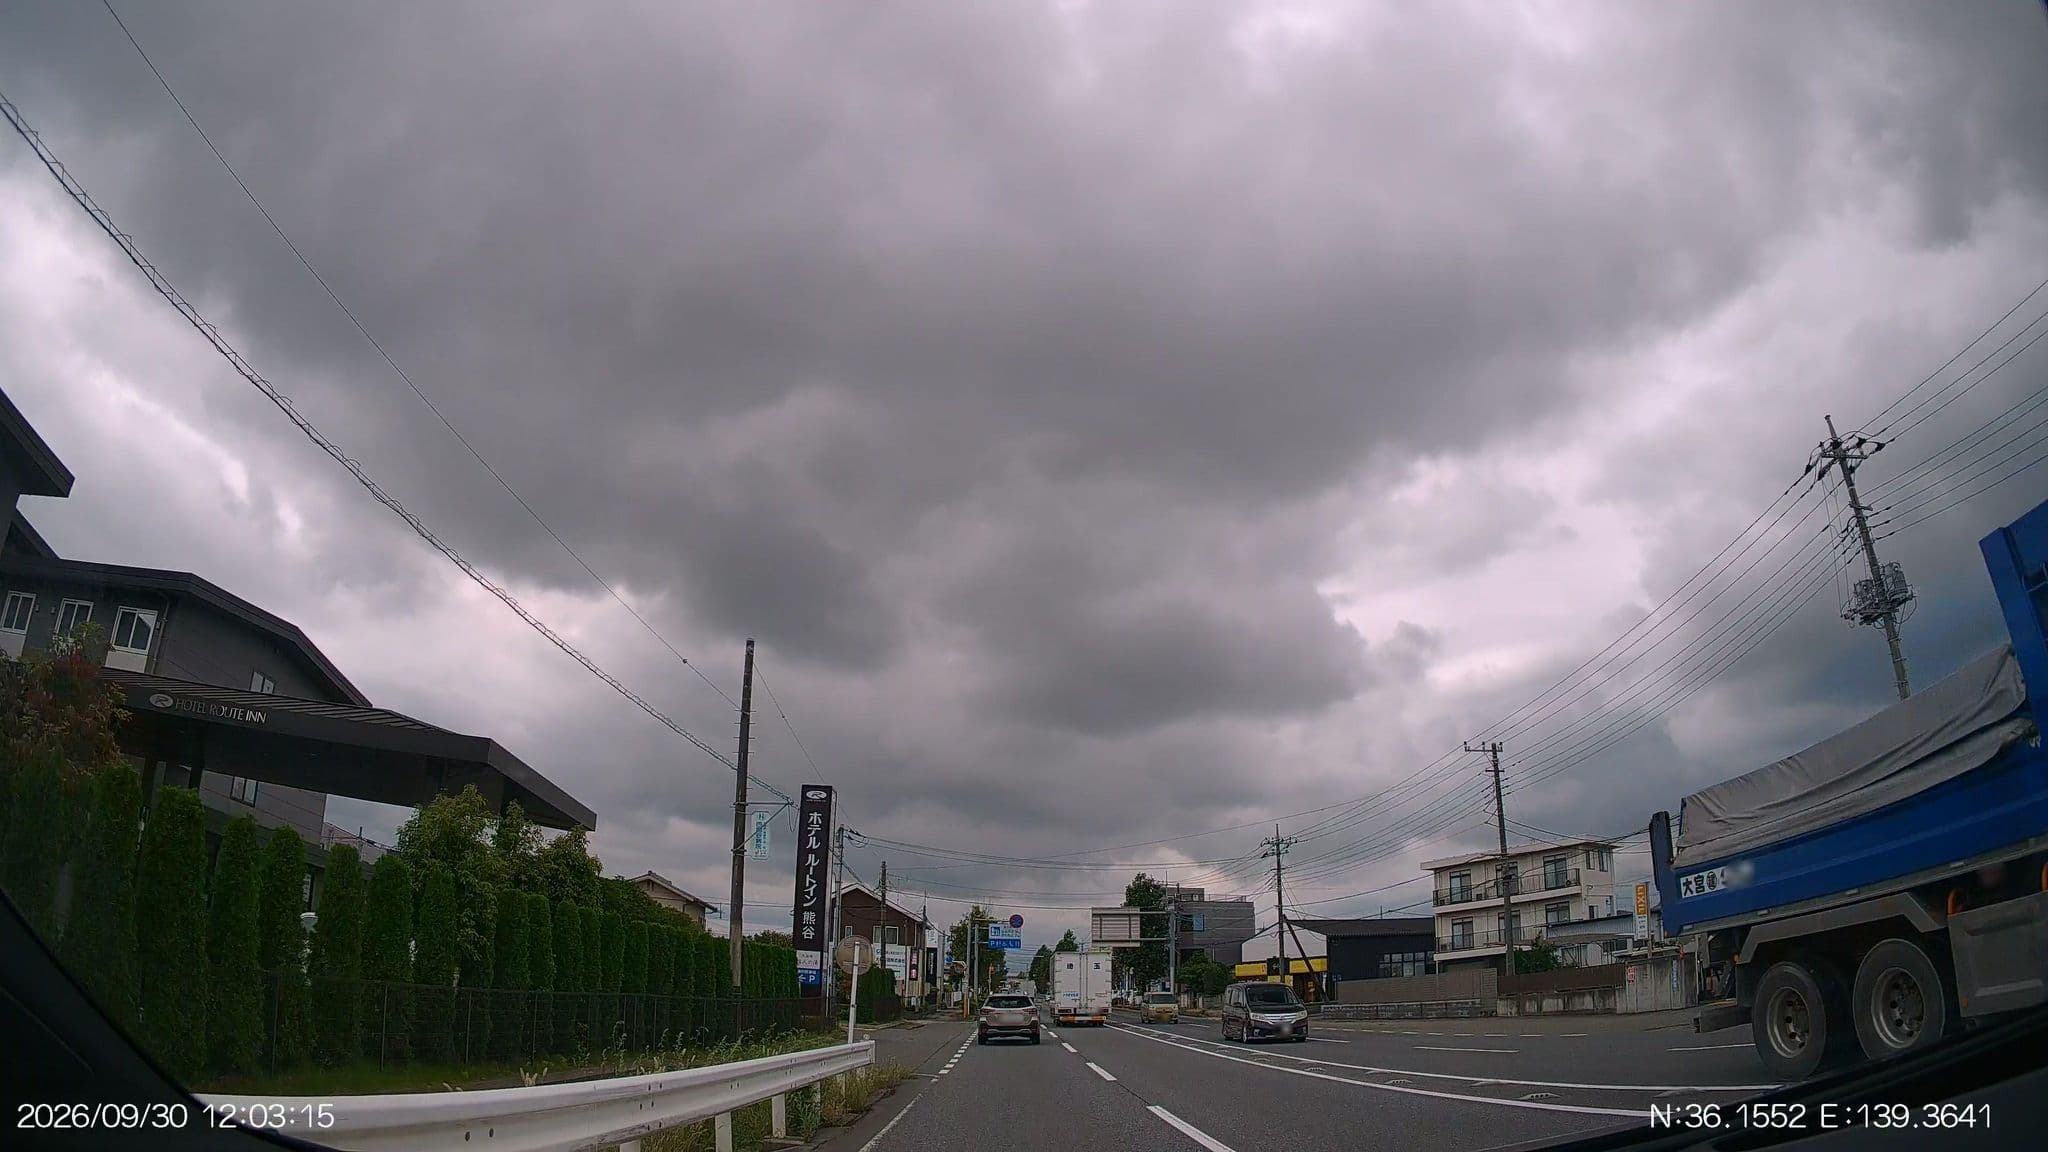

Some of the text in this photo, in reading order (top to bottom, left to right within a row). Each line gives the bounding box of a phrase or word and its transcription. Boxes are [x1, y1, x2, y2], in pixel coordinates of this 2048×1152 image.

[175, 698, 267, 723] HOTEL ROUTE INN
[806, 811, 822, 849] ホテル
[803, 853, 820, 907] ルートイン
[802, 911, 816, 940] 熊谷
[808, 975, 816, 983] P
